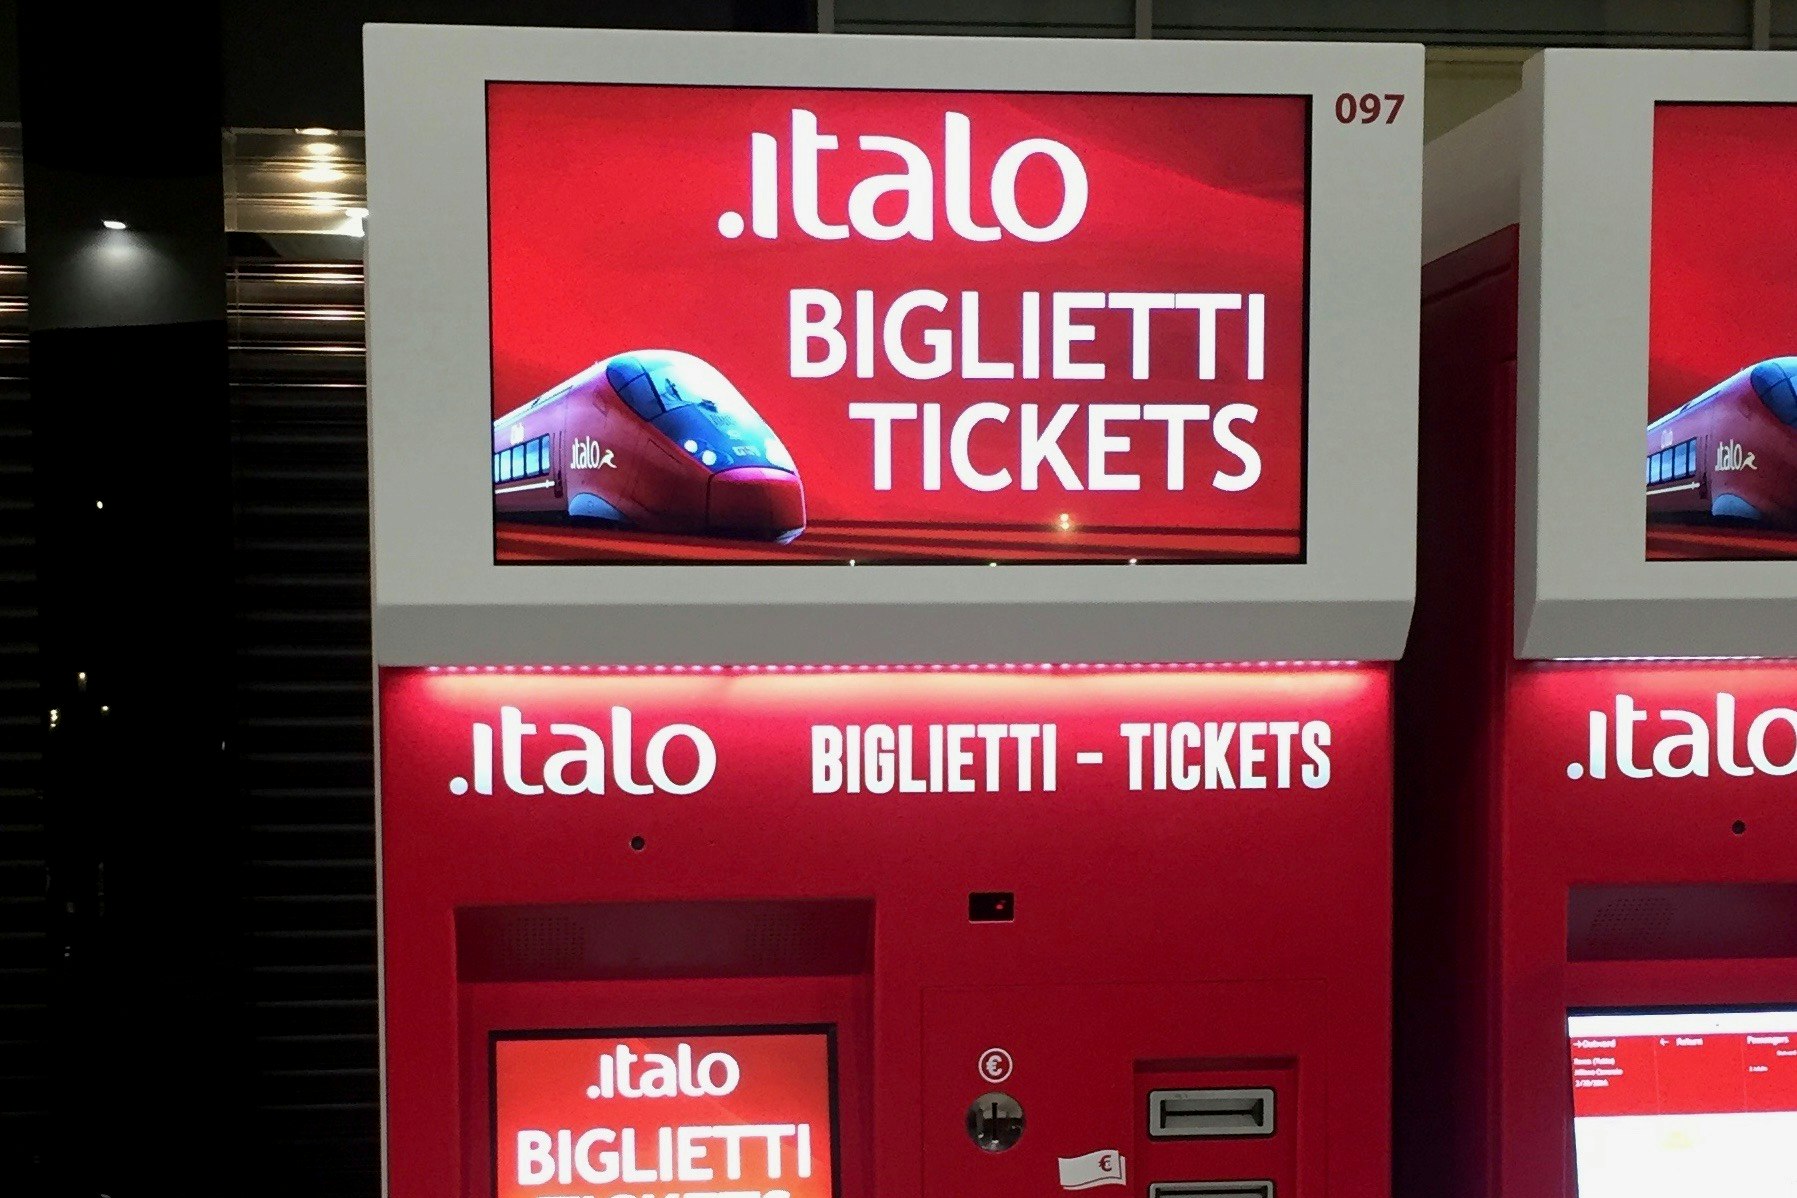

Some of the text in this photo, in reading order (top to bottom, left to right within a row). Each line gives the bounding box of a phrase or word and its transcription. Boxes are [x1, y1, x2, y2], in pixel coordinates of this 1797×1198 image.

[1335, 92, 1405, 124] 097
[789, 288, 1266, 380] BIGLIETTI
[848, 401, 1262, 492] TICKETS
[811, 723, 1057, 794] BIGLIETTI
[1119, 719, 1332, 790] TICKETS
[517, 1123, 812, 1186] BIGLIETTI
